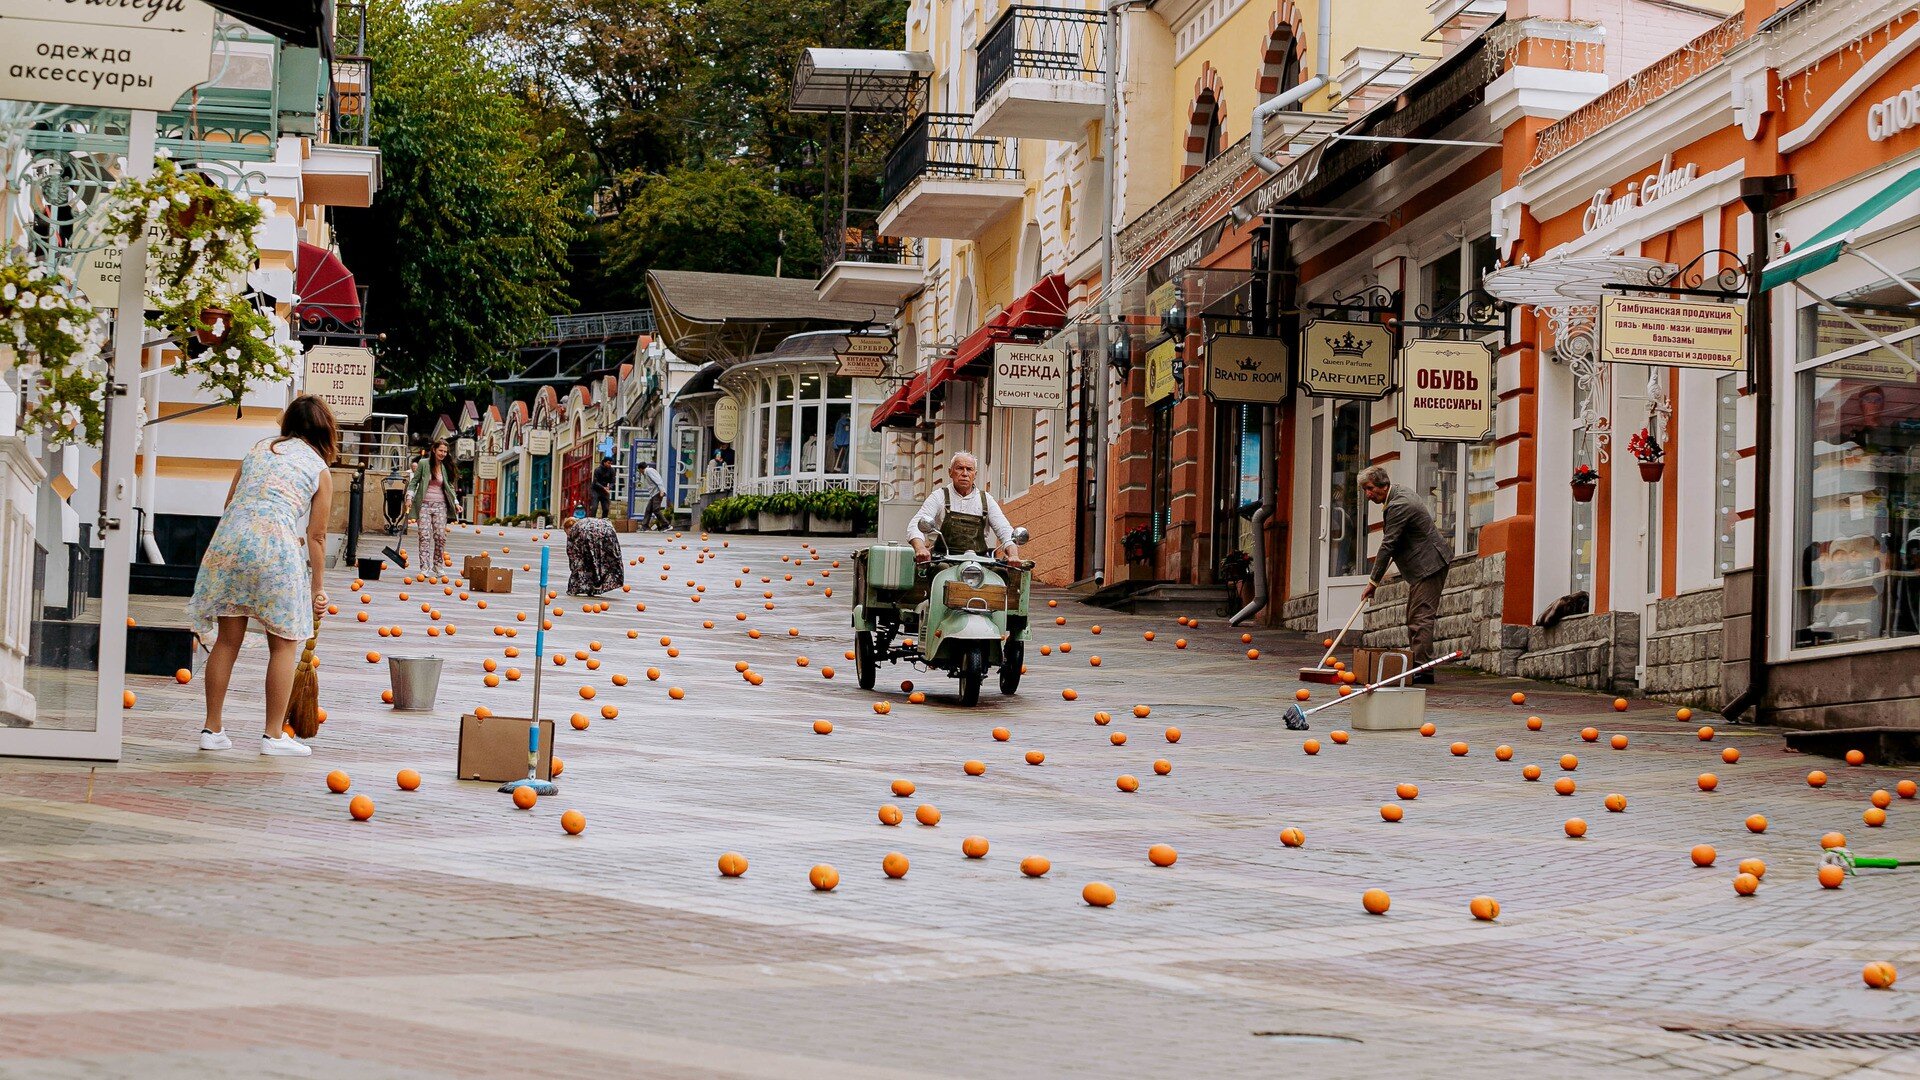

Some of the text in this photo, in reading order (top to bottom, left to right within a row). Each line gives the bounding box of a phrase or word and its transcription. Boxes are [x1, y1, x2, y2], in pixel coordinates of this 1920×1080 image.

[37, 43, 131, 64] одежда
[9, 64, 153, 92] аксессуары
[1257, 164, 1299, 213] PARFUMER
[1168, 237, 1203, 278] PARFUMER
[1617, 303, 1732, 320] Тамбуканская продукция
[1615, 321, 1733, 336] грязь мыло мази шампуни
[1652, 333, 1695, 345] бальзамы
[1010, 352, 1054, 363] ЖЕНСКАЯ
[1615, 347, 1630, 355] все
[1631, 348, 1647, 356] для
[1648, 349, 1684, 358] красоты
[1692, 352, 1732, 362] здоровья
[311, 362, 367, 376] КОНФЕТЫ
[1323, 358, 1373, 368] Queen Parfume
[998, 363, 1061, 381] ОДЕЖДА
[1214, 367, 1282, 383] BRAND ROOM
[1310, 367, 1387, 387] PARFUMER
[1416, 368, 1479, 391] ОБУВЬ
[332, 380, 345, 390] ИЗ
[998, 390, 1060, 400] РЕМОНТ ЧАСОВ
[1413, 396, 1482, 410] АКСЕССУАРЫ
